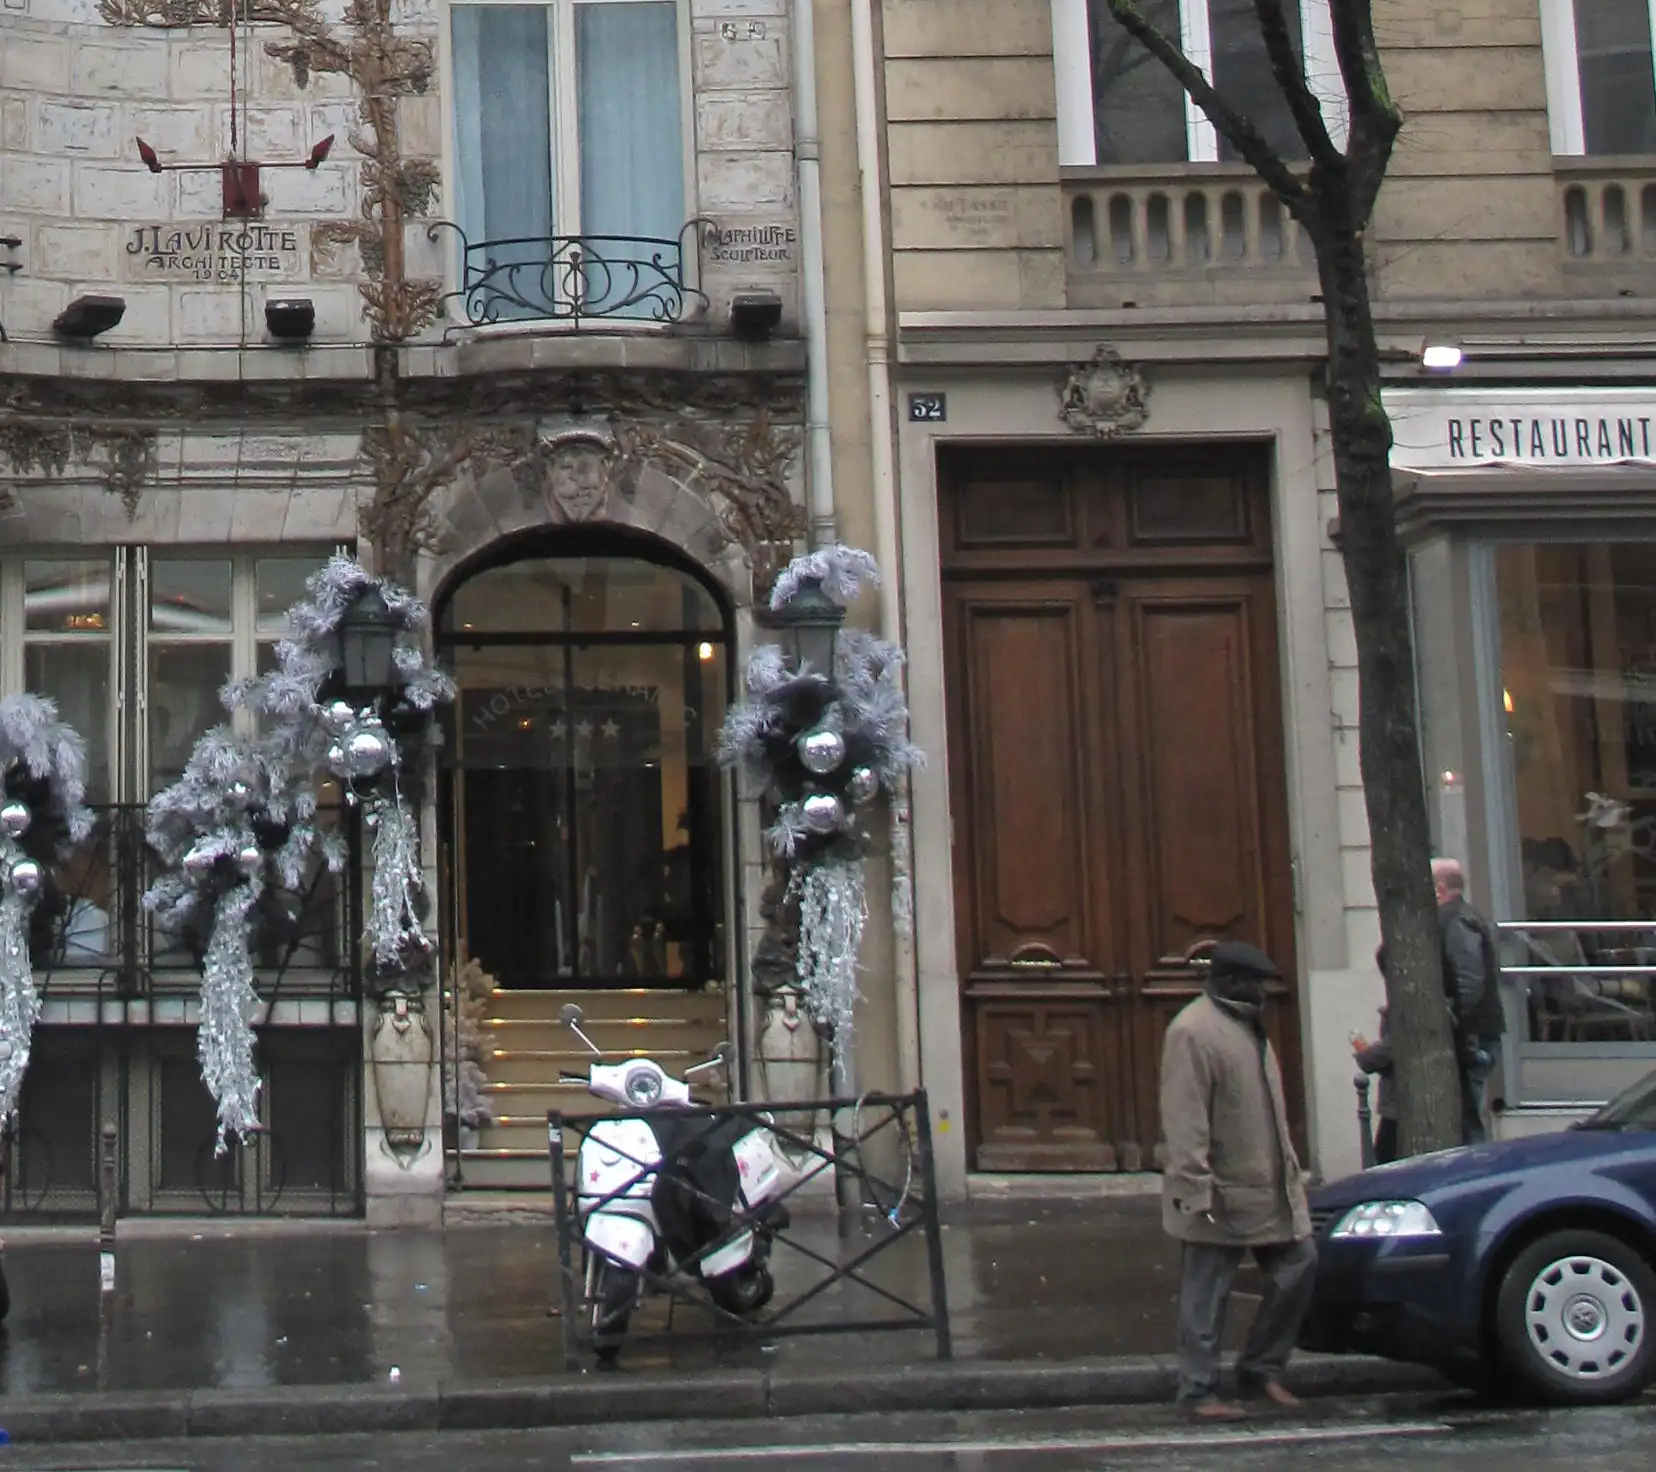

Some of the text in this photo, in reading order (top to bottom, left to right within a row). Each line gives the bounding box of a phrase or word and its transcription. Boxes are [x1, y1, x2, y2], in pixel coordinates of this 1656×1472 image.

[145, 255, 281, 270] ARCHITECTE
[710, 246, 792, 262] SCULPTEUR
[913, 397, 942, 418] 52
[1447, 417, 1651, 458] RESTAURANT
